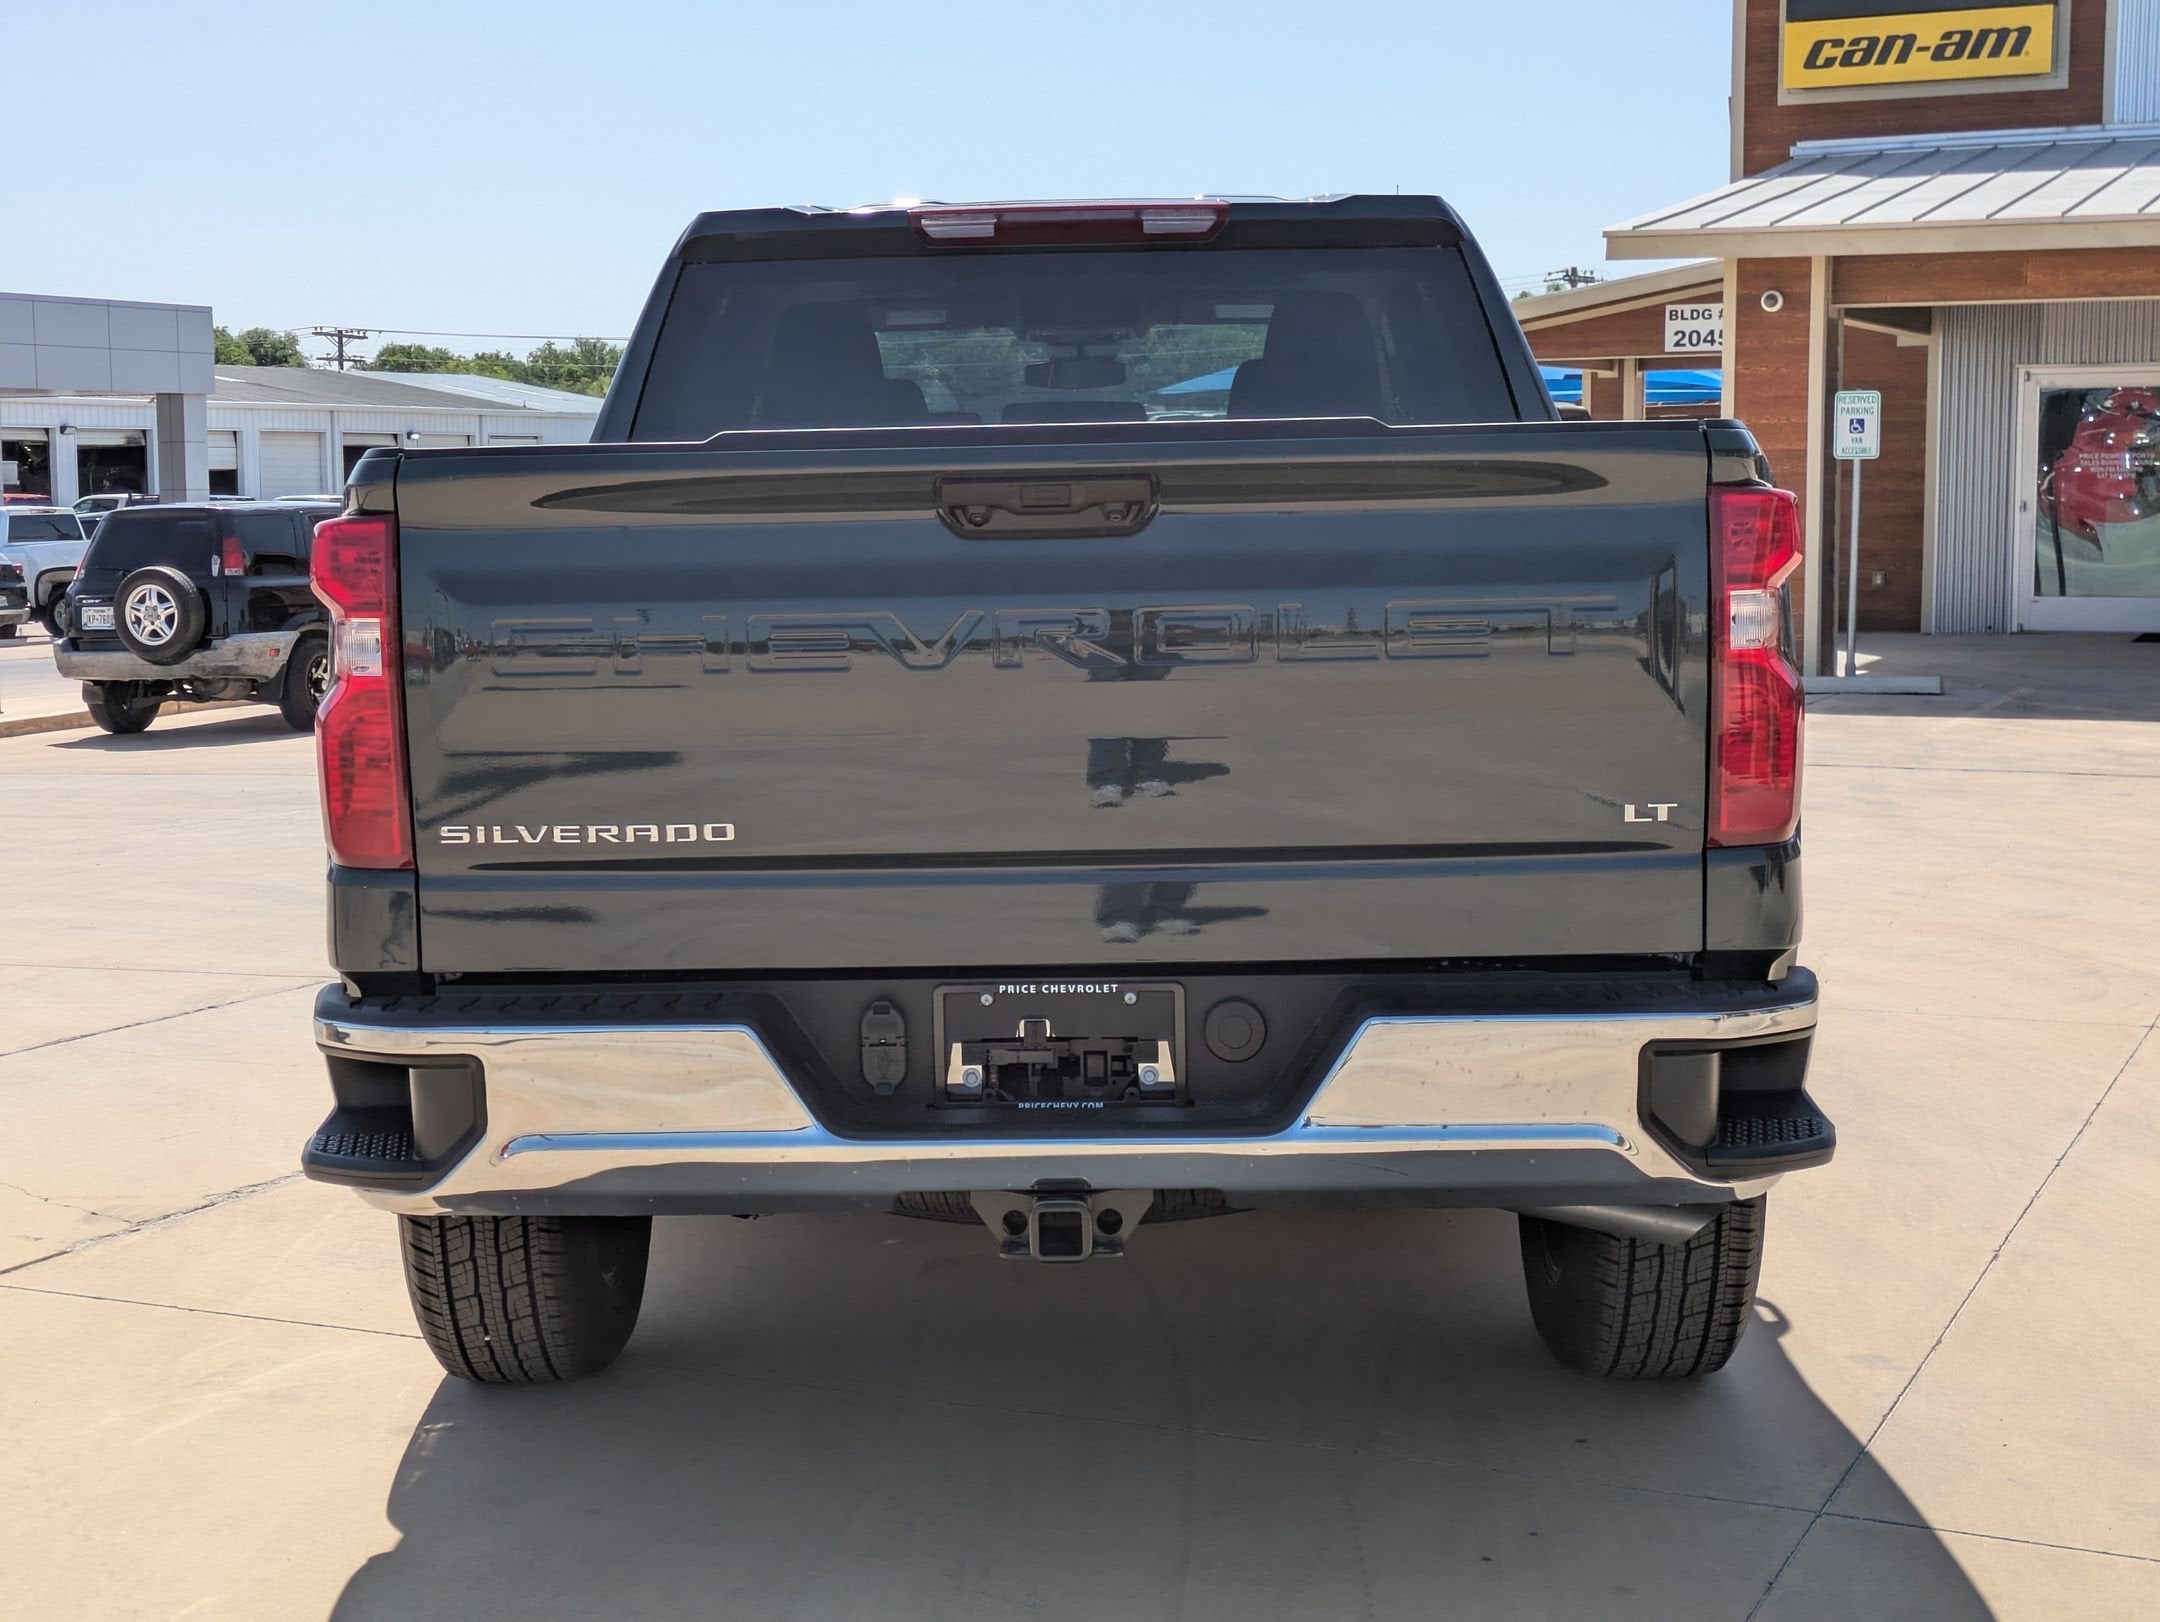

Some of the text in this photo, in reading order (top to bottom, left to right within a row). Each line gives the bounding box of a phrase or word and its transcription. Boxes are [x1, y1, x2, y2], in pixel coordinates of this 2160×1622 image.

[1803, 25, 2032, 70] can-am
[1669, 308, 1713, 321] BLDG
[1838, 395, 1877, 404] RESERVED
[1840, 407, 1875, 415] PARKING
[491, 596, 1618, 677] CHEVROLET
[1624, 803, 1678, 822] LT
[440, 823, 735, 844] SILVERADO
[999, 984, 1119, 994] PRICE CHEVROLET
[1018, 1101, 1104, 1109] PRICECHEVYCOM
